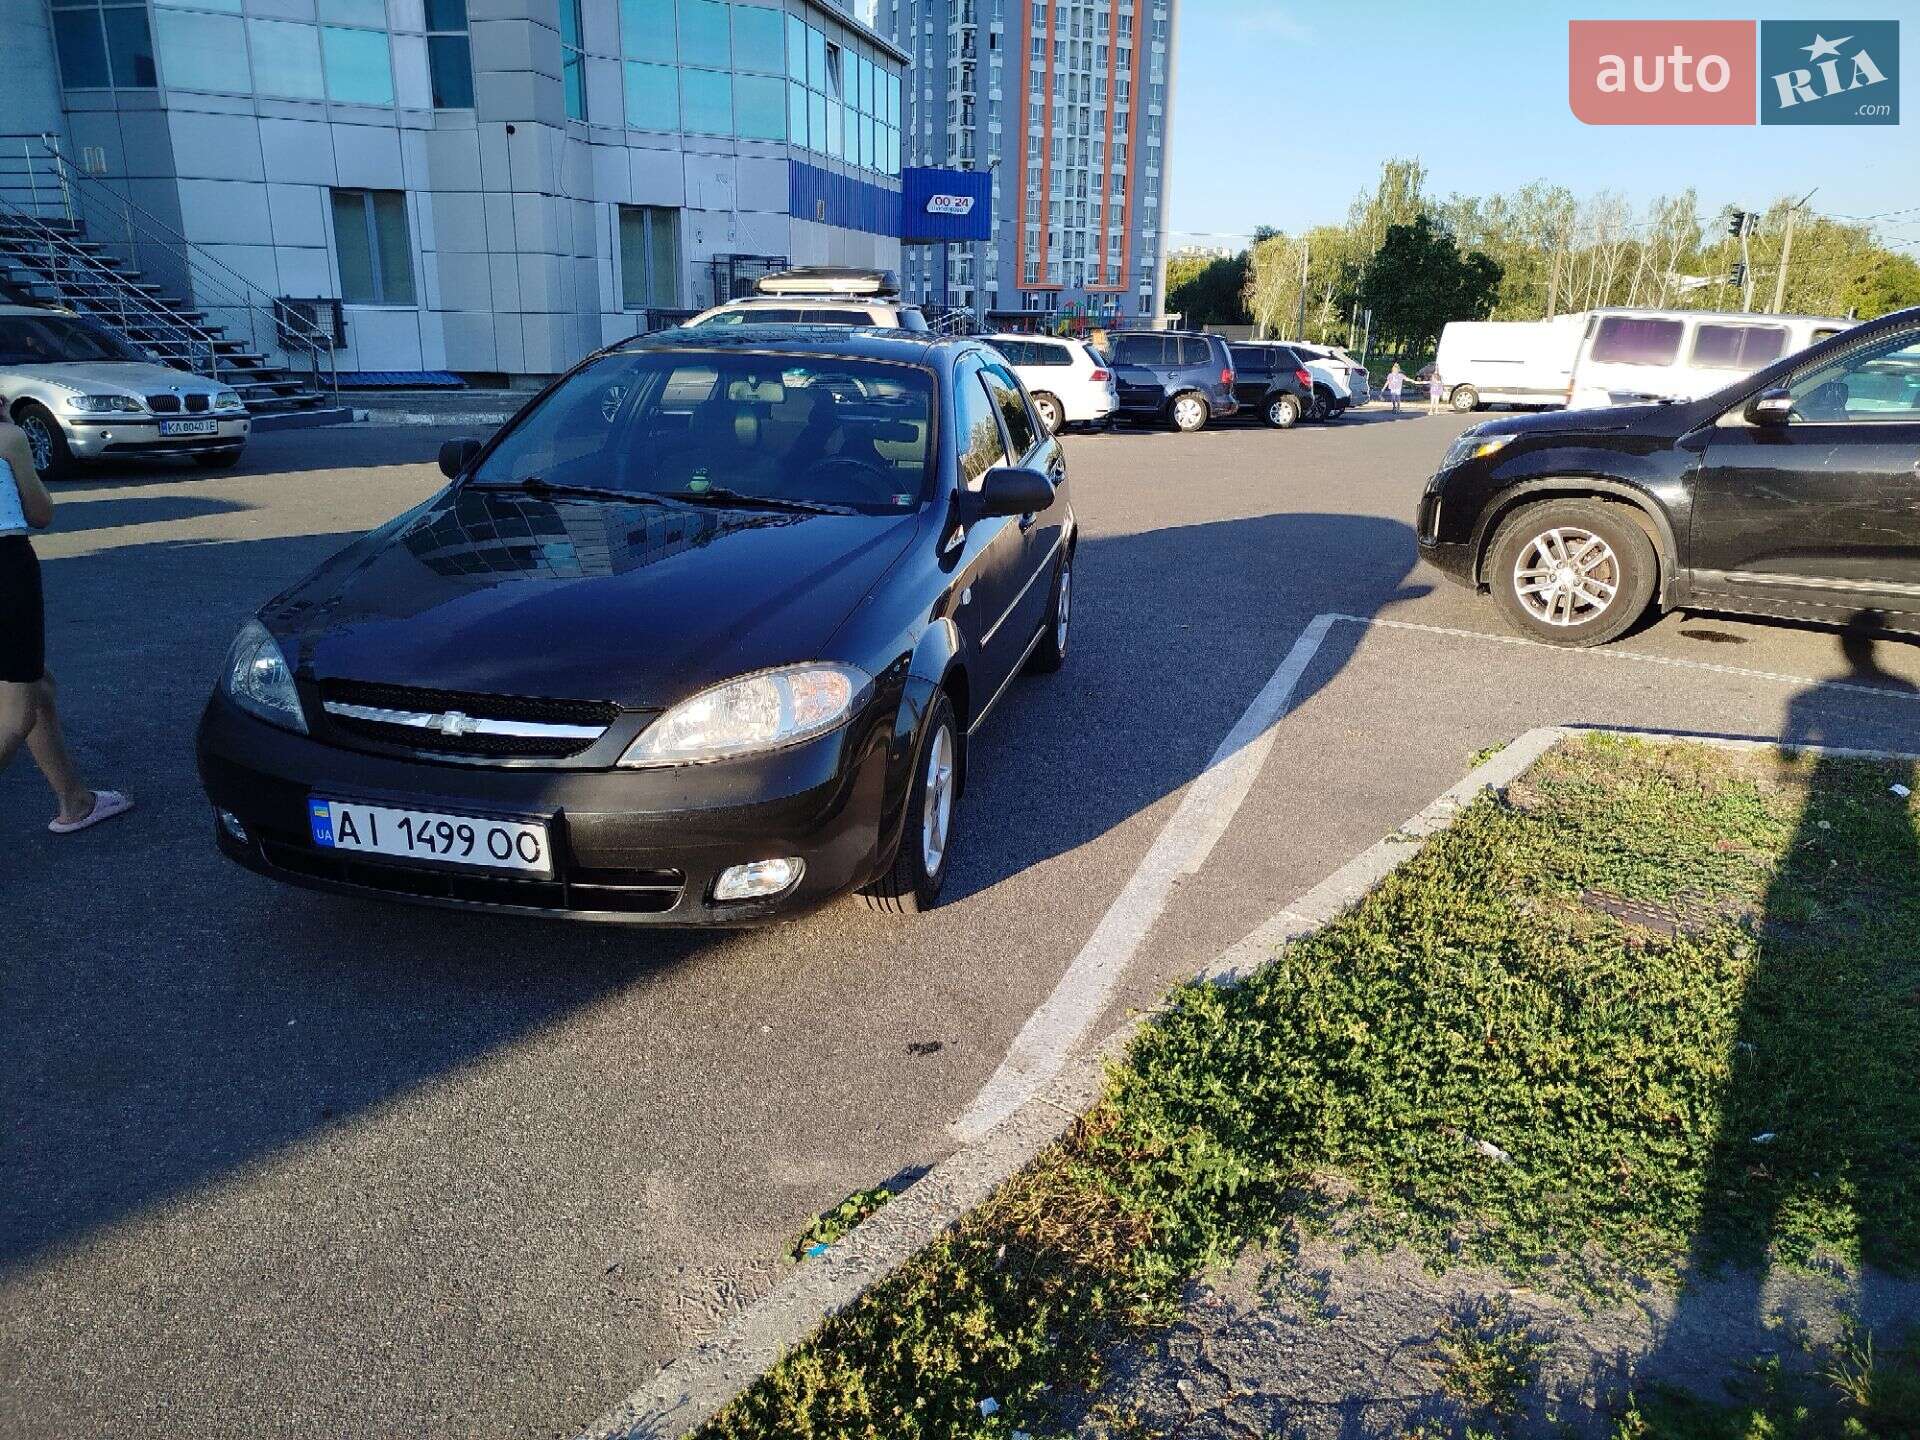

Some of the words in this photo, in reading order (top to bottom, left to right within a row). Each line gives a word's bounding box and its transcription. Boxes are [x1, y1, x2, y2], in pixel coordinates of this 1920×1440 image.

[316, 829, 333, 841] UA
[338, 810, 379, 846] AI
[397, 816, 475, 857] 1499
